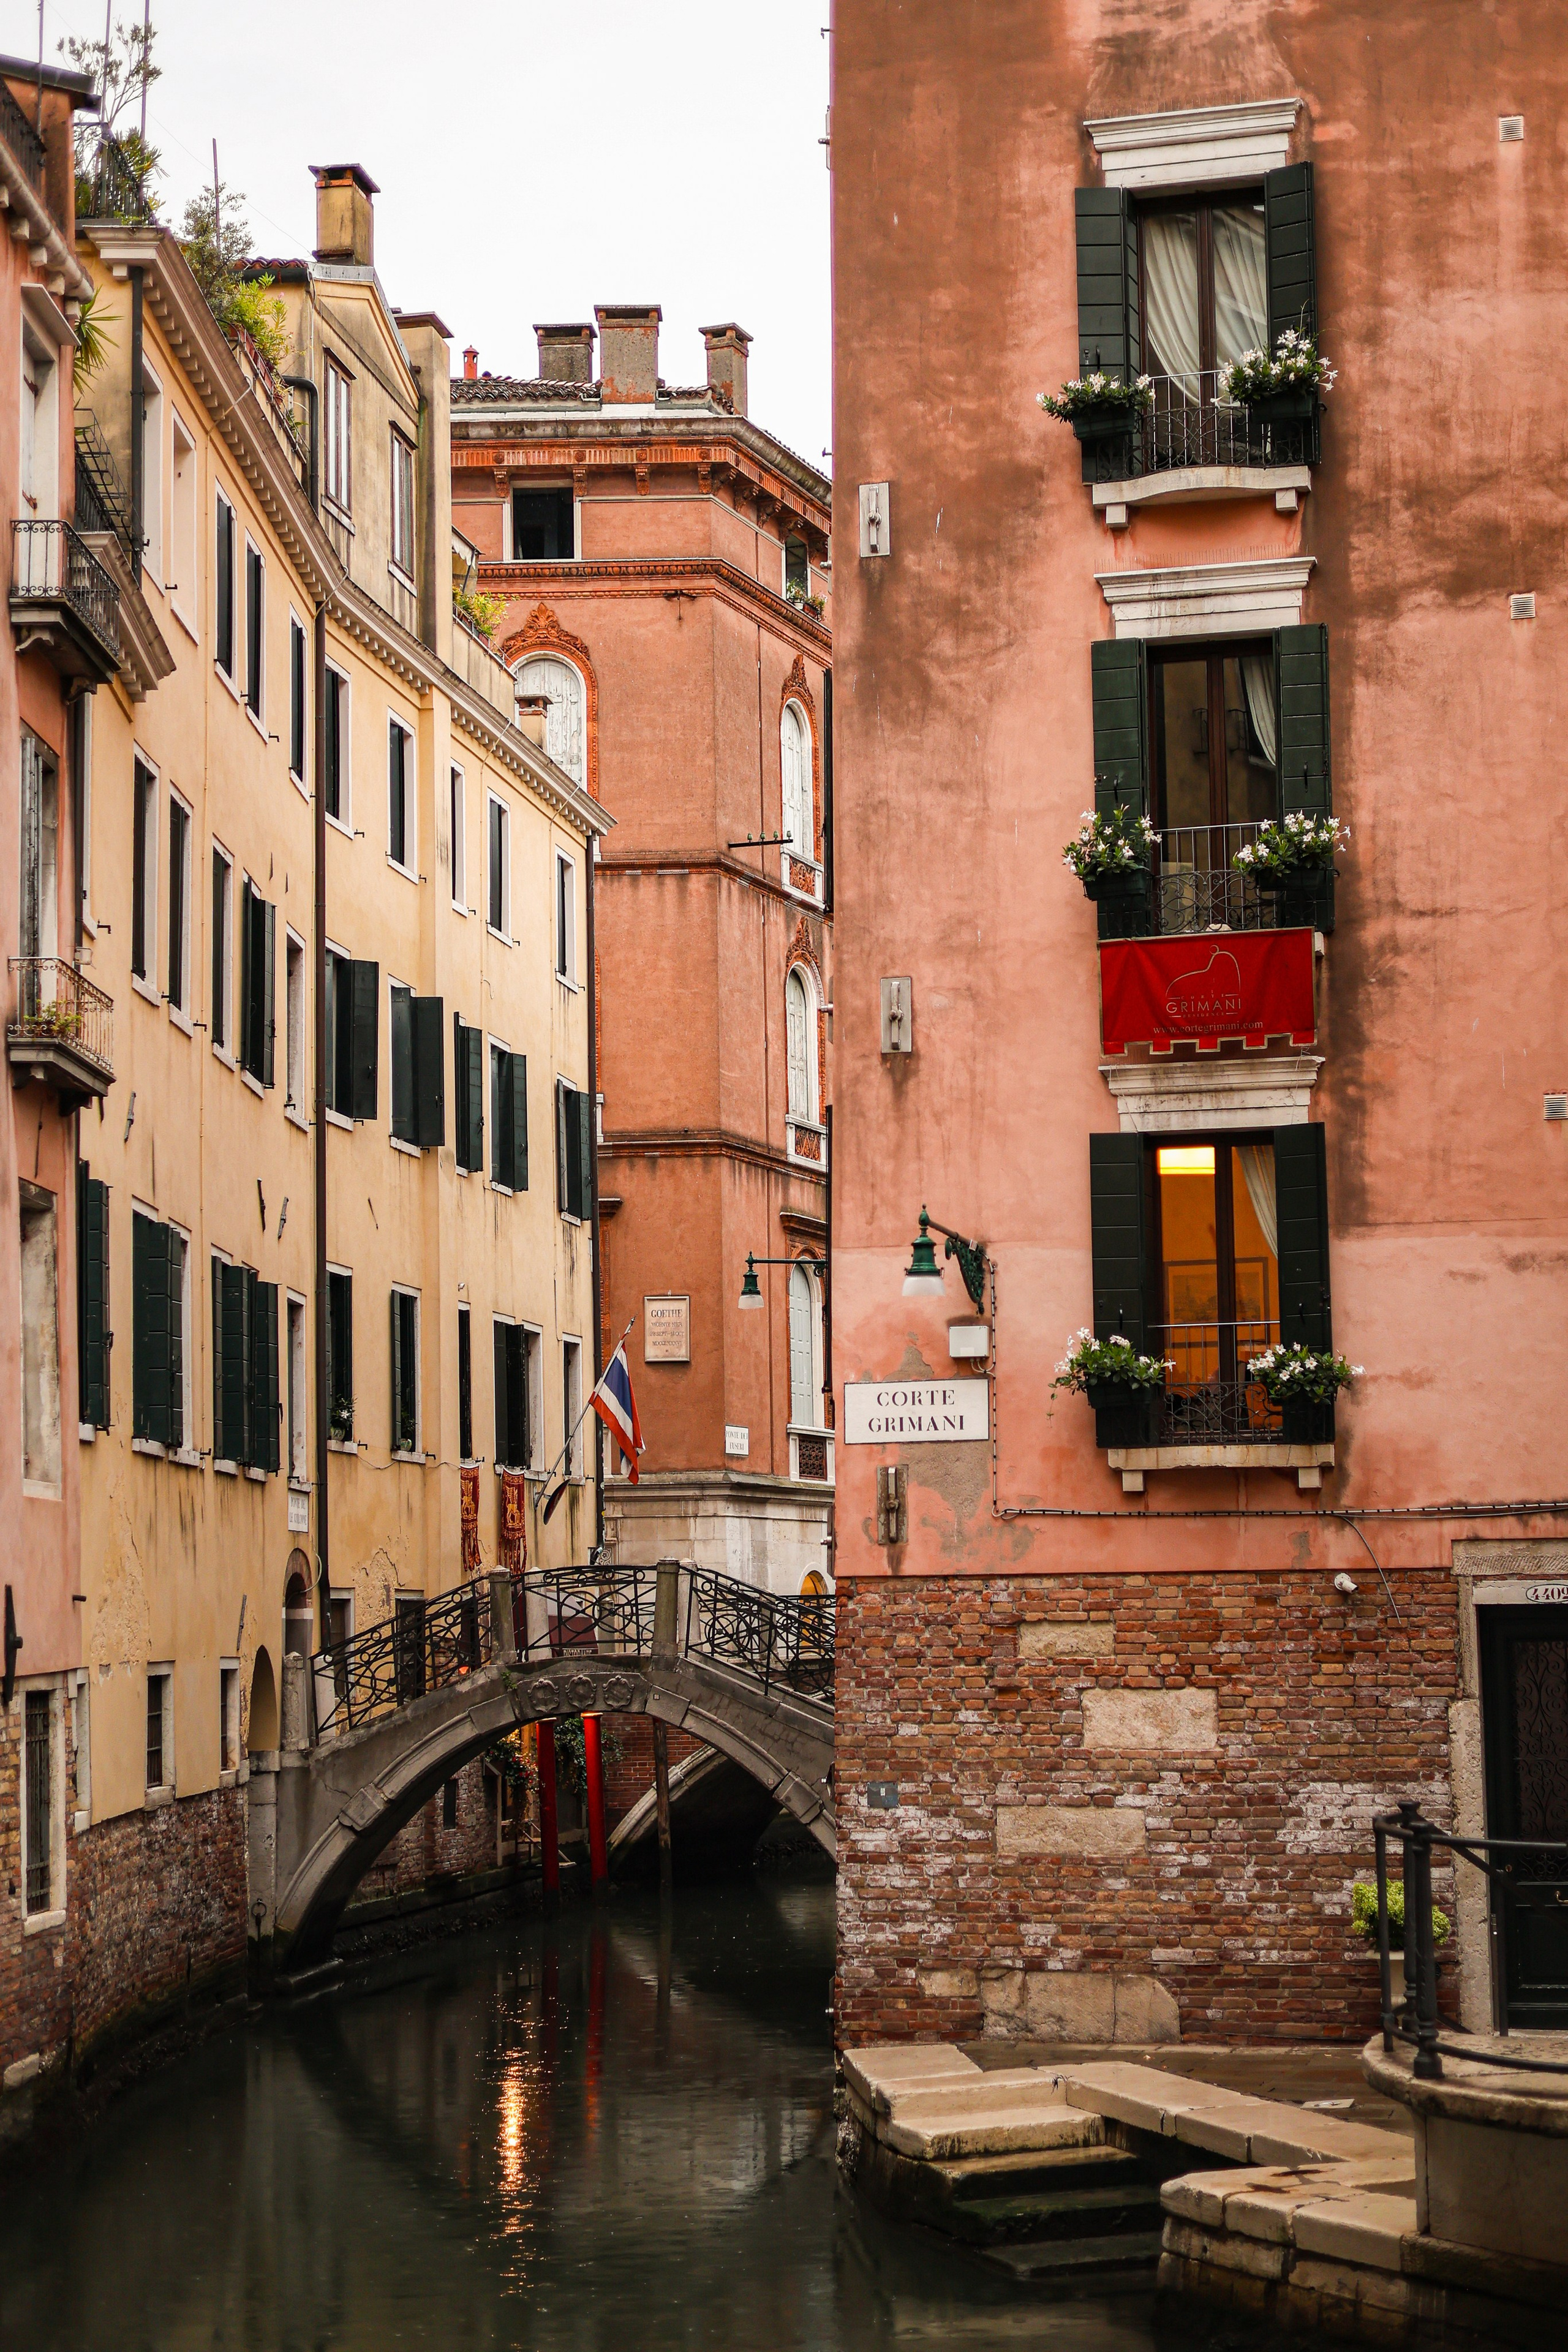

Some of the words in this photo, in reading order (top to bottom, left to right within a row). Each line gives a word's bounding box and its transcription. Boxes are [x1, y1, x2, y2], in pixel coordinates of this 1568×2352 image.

[1166, 998, 1241, 1013] GRIMANI
[1153, 1021, 1263, 1034] www.cortegrimani.com
[876, 1389, 955, 1407] CORTE
[868, 1415, 965, 1433] GRIMANI
